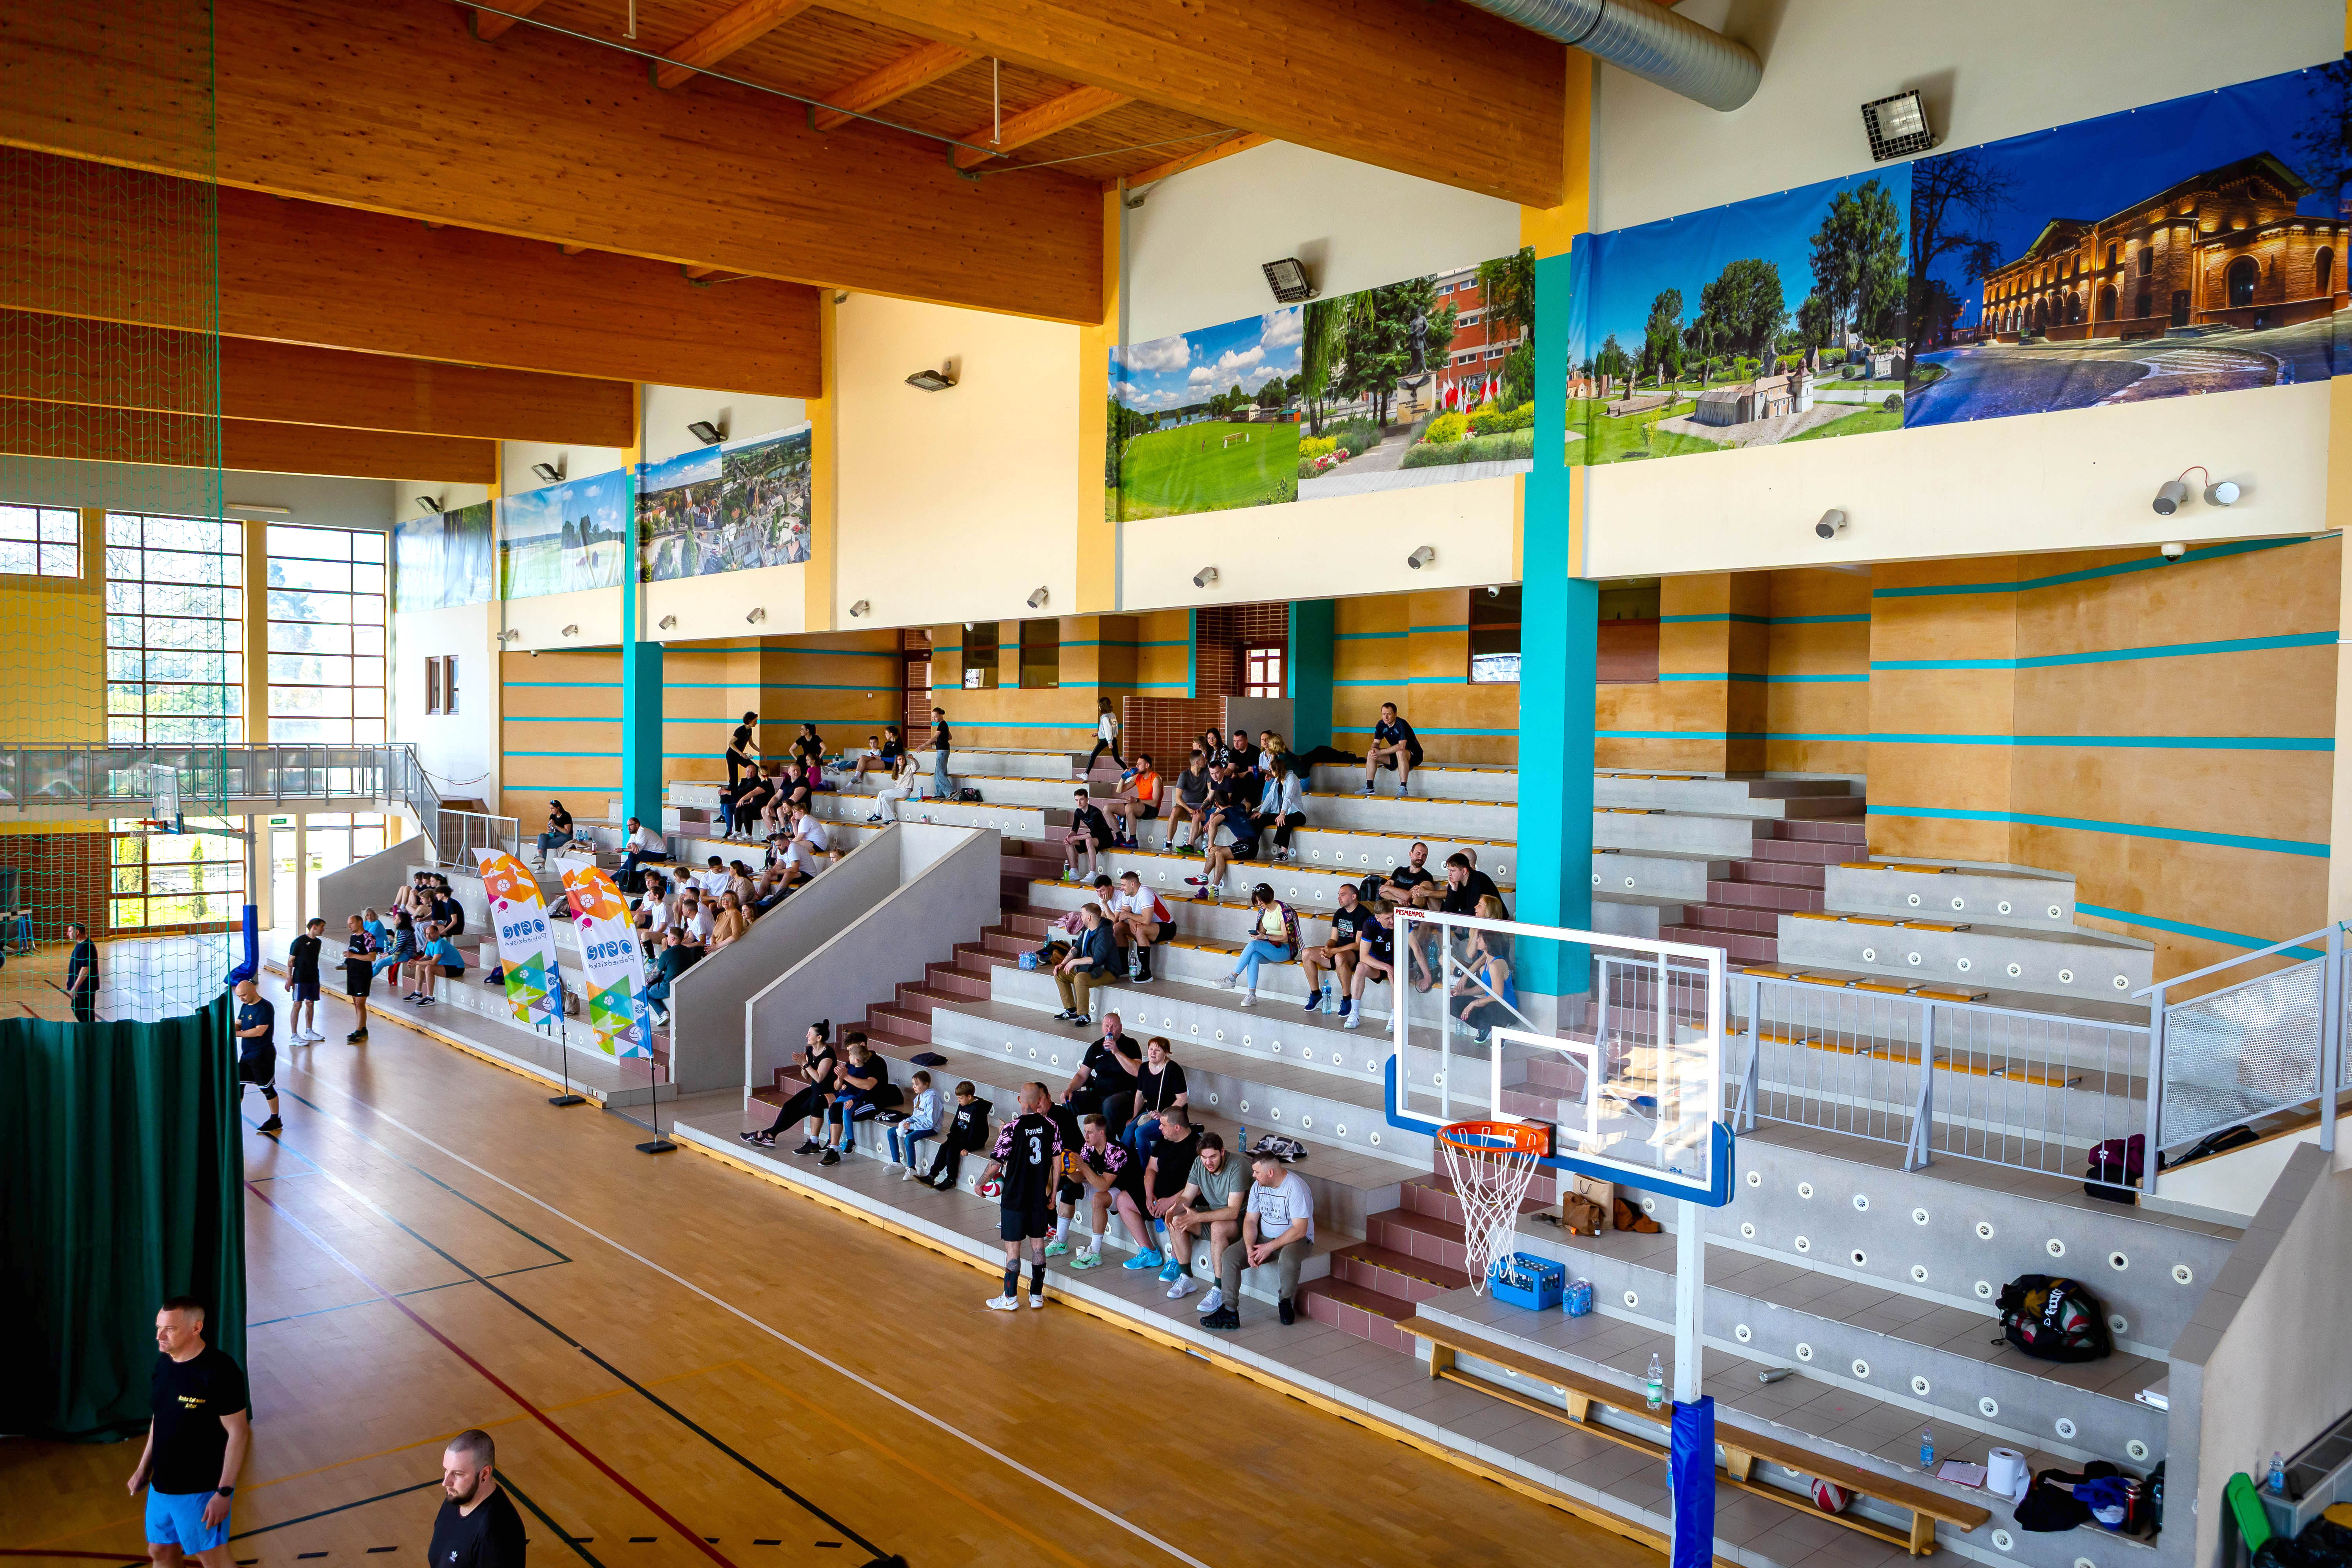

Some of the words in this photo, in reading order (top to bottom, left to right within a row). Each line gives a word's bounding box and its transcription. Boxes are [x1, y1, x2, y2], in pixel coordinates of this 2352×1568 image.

[1385, 942, 1390, 951] 6
[958, 1111, 971, 1123] NASA
[1029, 1136, 1041, 1164] 3
